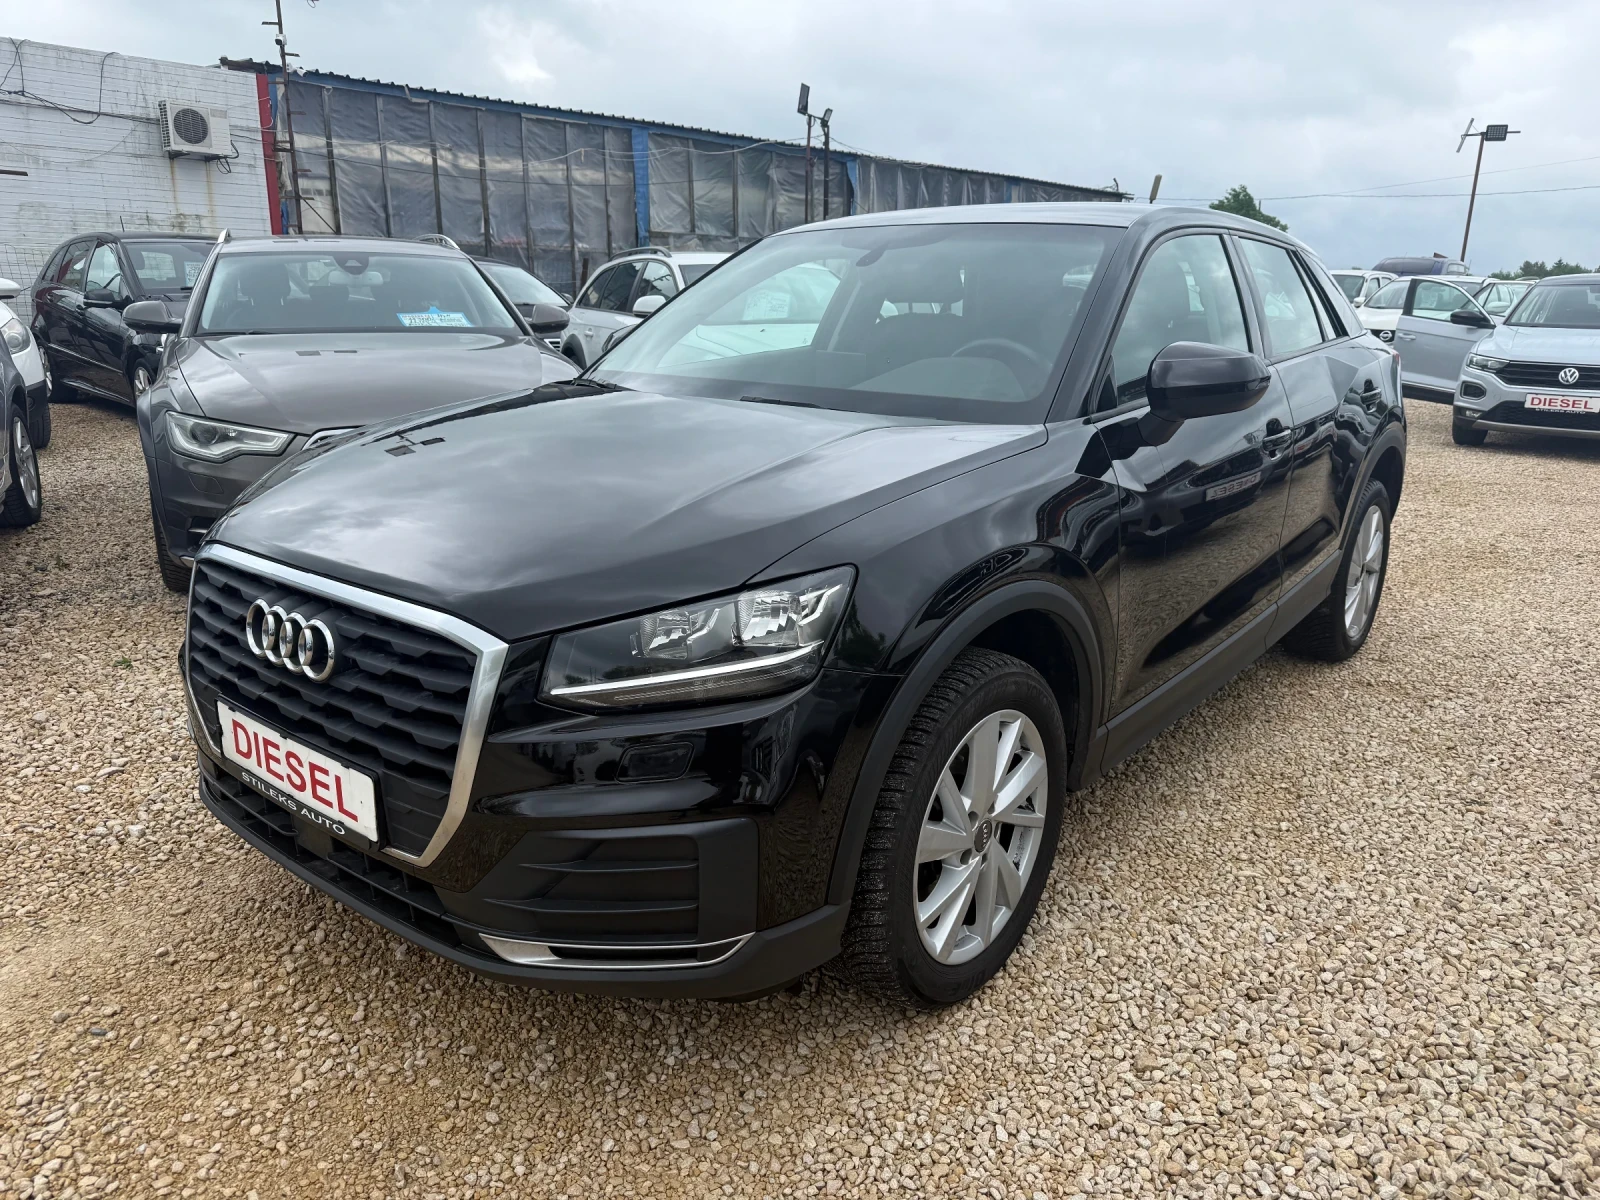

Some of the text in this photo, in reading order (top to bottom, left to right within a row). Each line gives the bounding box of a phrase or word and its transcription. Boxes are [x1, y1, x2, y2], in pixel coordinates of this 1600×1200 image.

[1531, 397, 1593, 410] DIESEL
[231, 718, 359, 823] DIESEL
[241, 771, 346, 835] STILEKS AUTO
